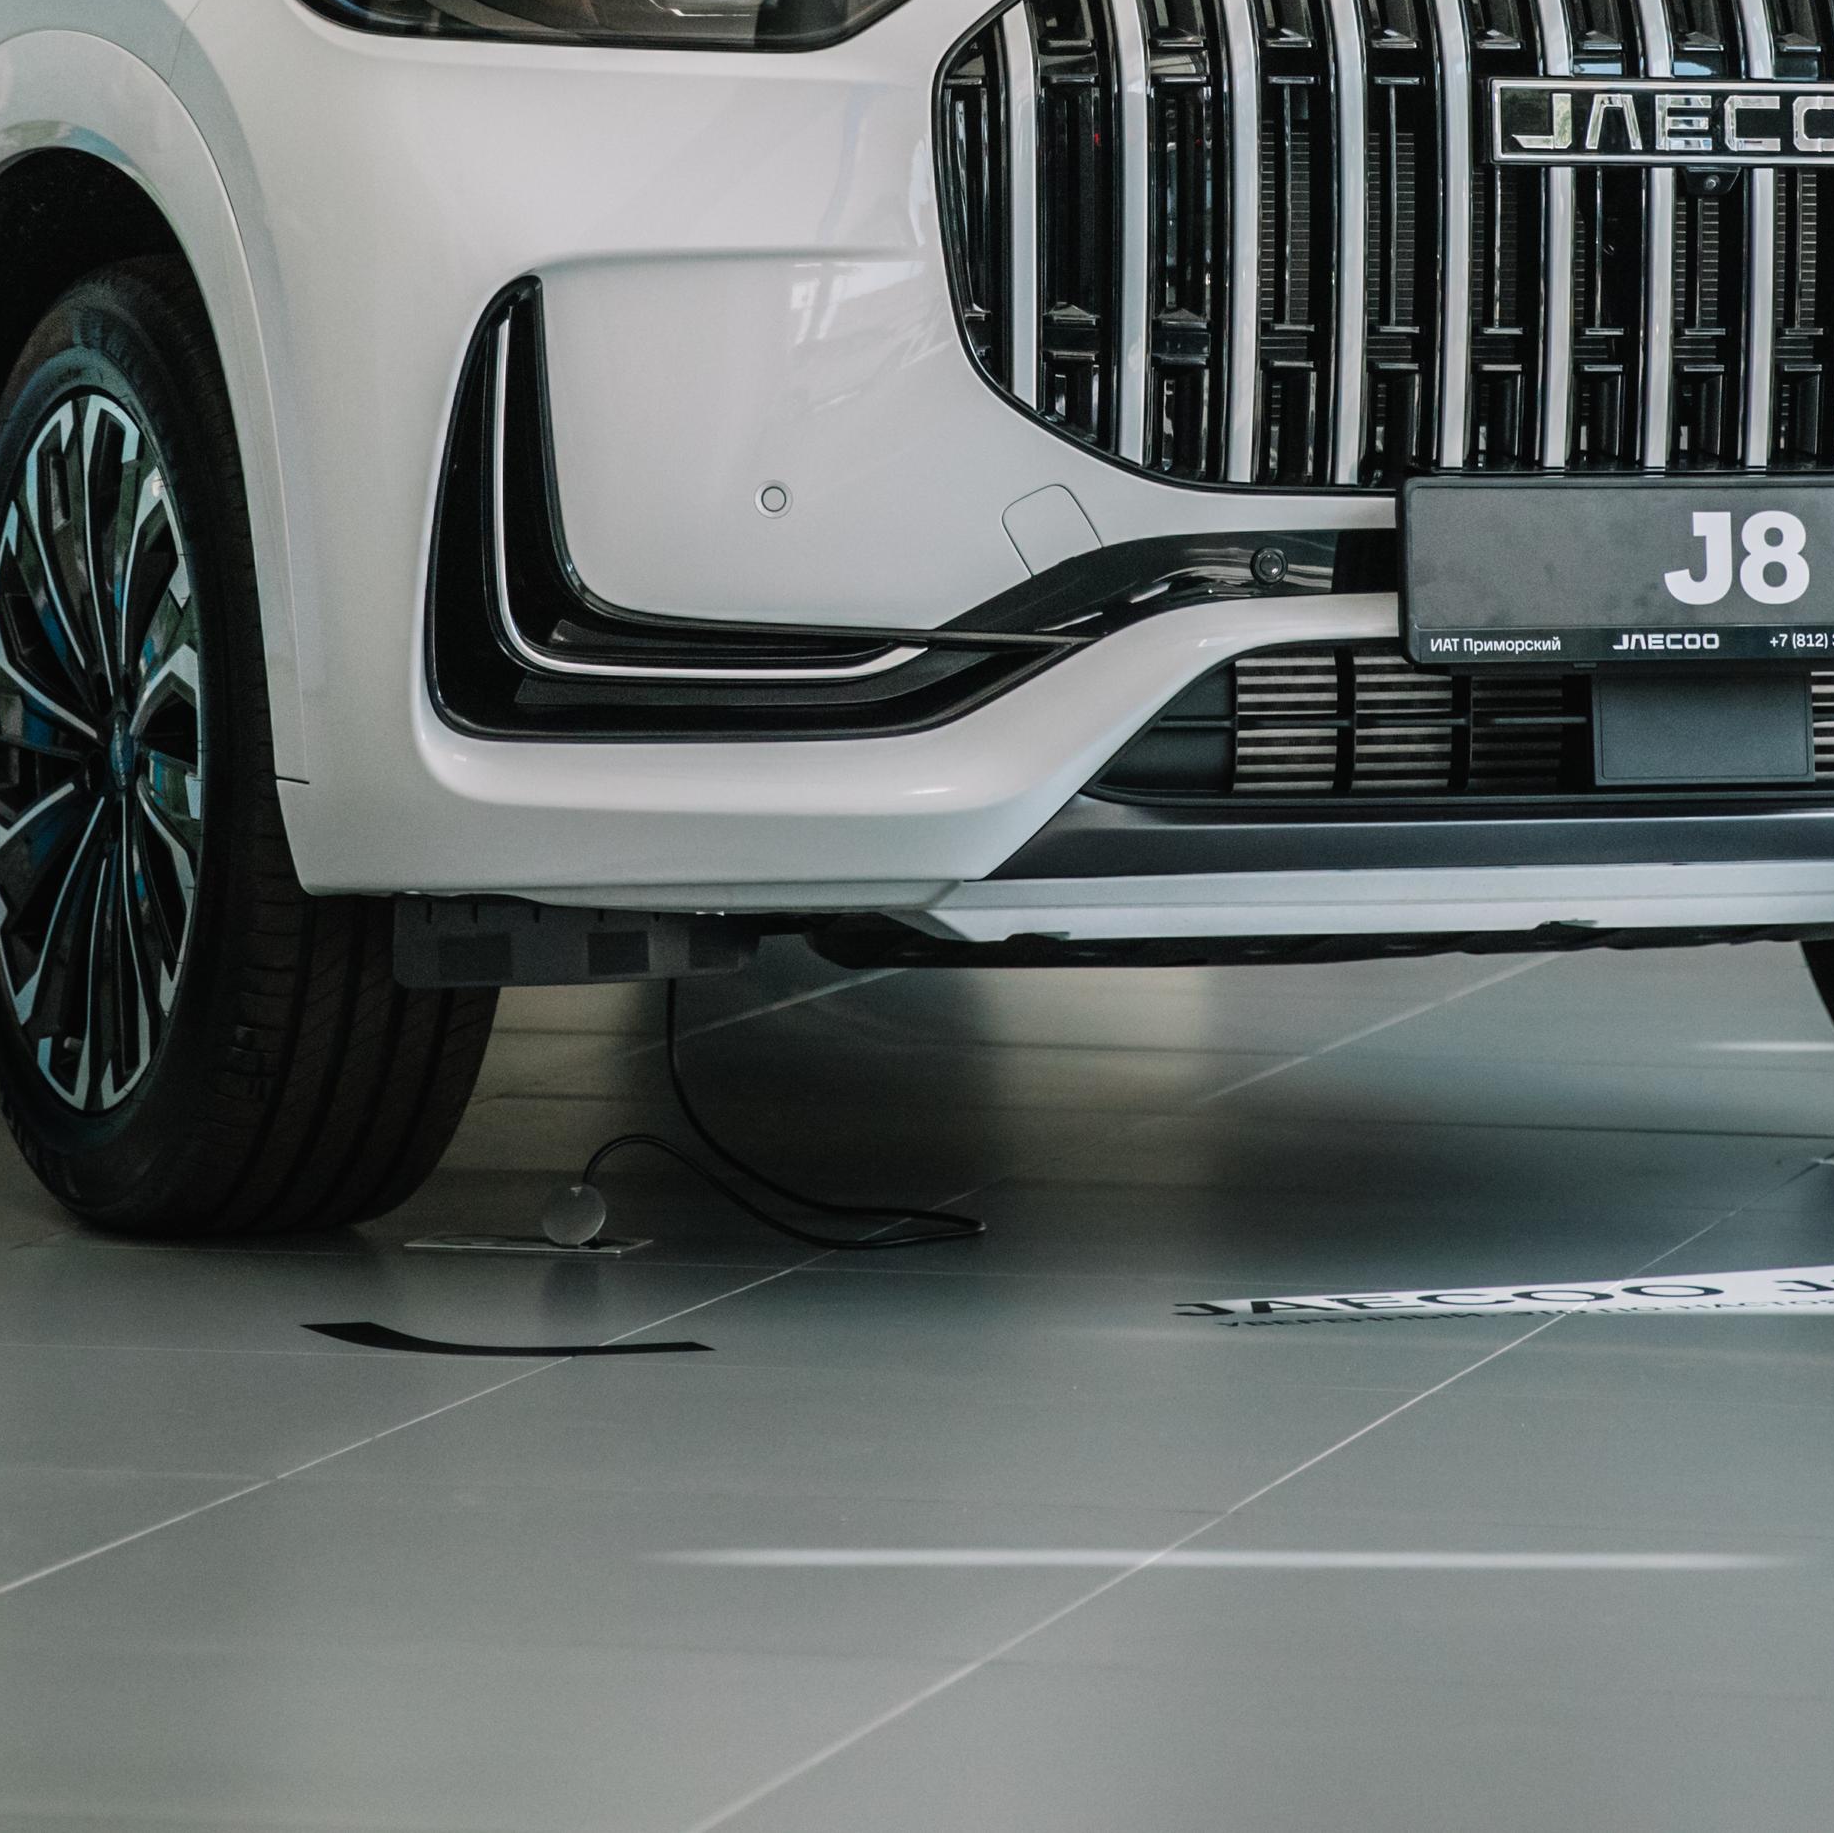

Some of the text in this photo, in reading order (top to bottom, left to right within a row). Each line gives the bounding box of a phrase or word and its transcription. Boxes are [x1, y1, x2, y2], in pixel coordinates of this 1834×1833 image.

[1663, 510, 1810, 606] J8
[1430, 636, 1561, 655] ИАТ Приморский
[1612, 633, 1720, 650] JAECOO
[1769, 633, 1788, 648] +7
[1792, 632, 1829, 650] (812)
[1173, 1283, 1725, 1317] JAECOO
